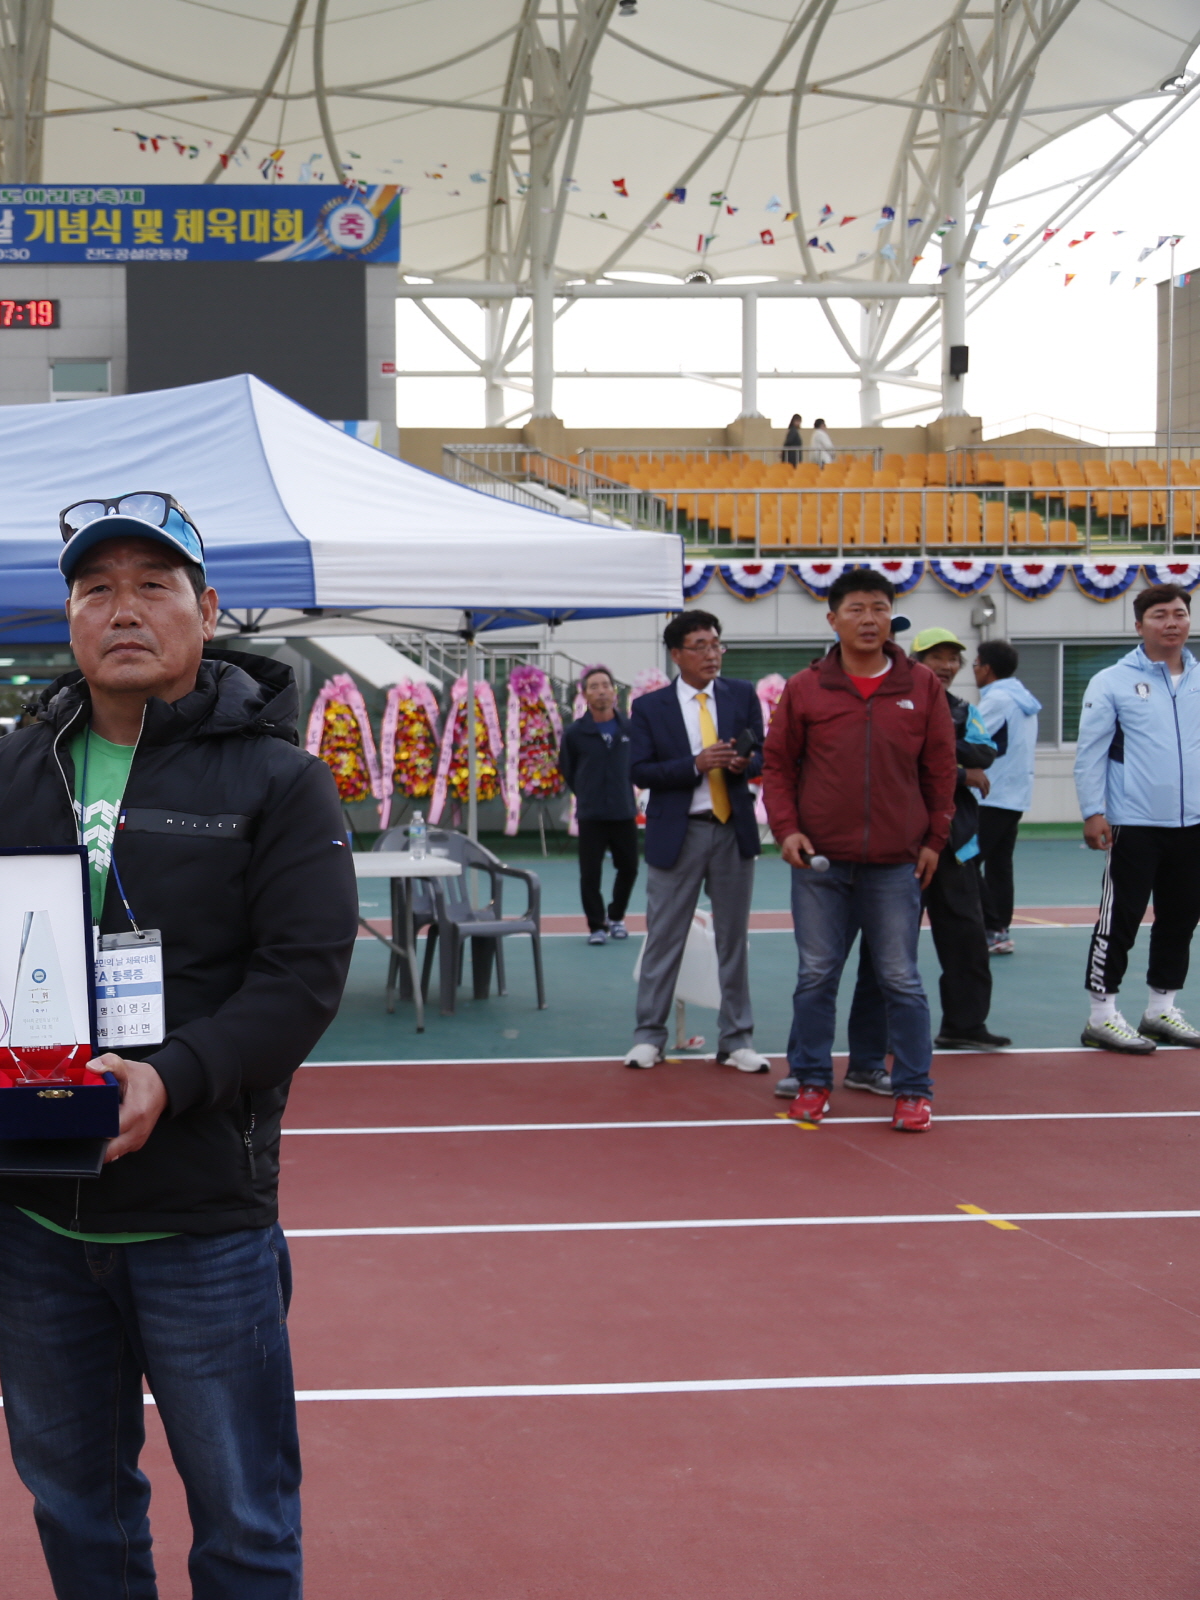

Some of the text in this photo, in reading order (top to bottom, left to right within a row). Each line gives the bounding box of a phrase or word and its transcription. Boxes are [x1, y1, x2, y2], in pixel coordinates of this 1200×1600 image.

[24, 209, 121, 244] 기념식
[133, 209, 164, 244] 및
[172, 208, 303, 244] 체육대회
[338, 213, 365, 240] 축
[85, 248, 189, 261] 진도공설운동장
[112, 969, 144, 982] 등록증
[1090, 935, 1109, 994] PALACE
